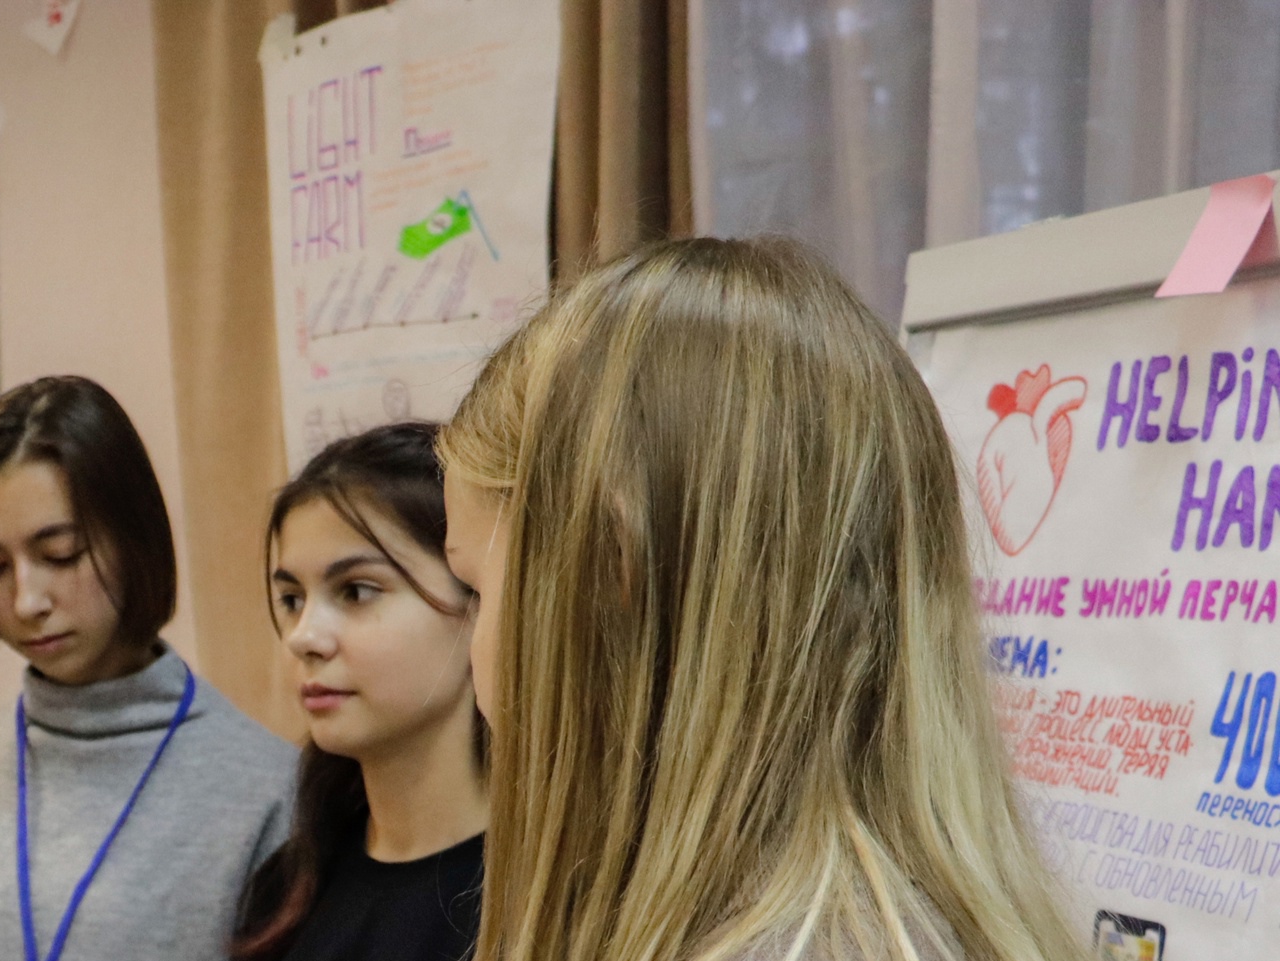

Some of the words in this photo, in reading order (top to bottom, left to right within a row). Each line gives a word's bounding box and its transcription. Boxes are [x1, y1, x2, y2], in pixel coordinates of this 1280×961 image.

[290, 170, 365, 267] FARM
[1079, 568, 1172, 619] УМНОЙ
[1178, 579, 1277, 624] ПЕРЧА
